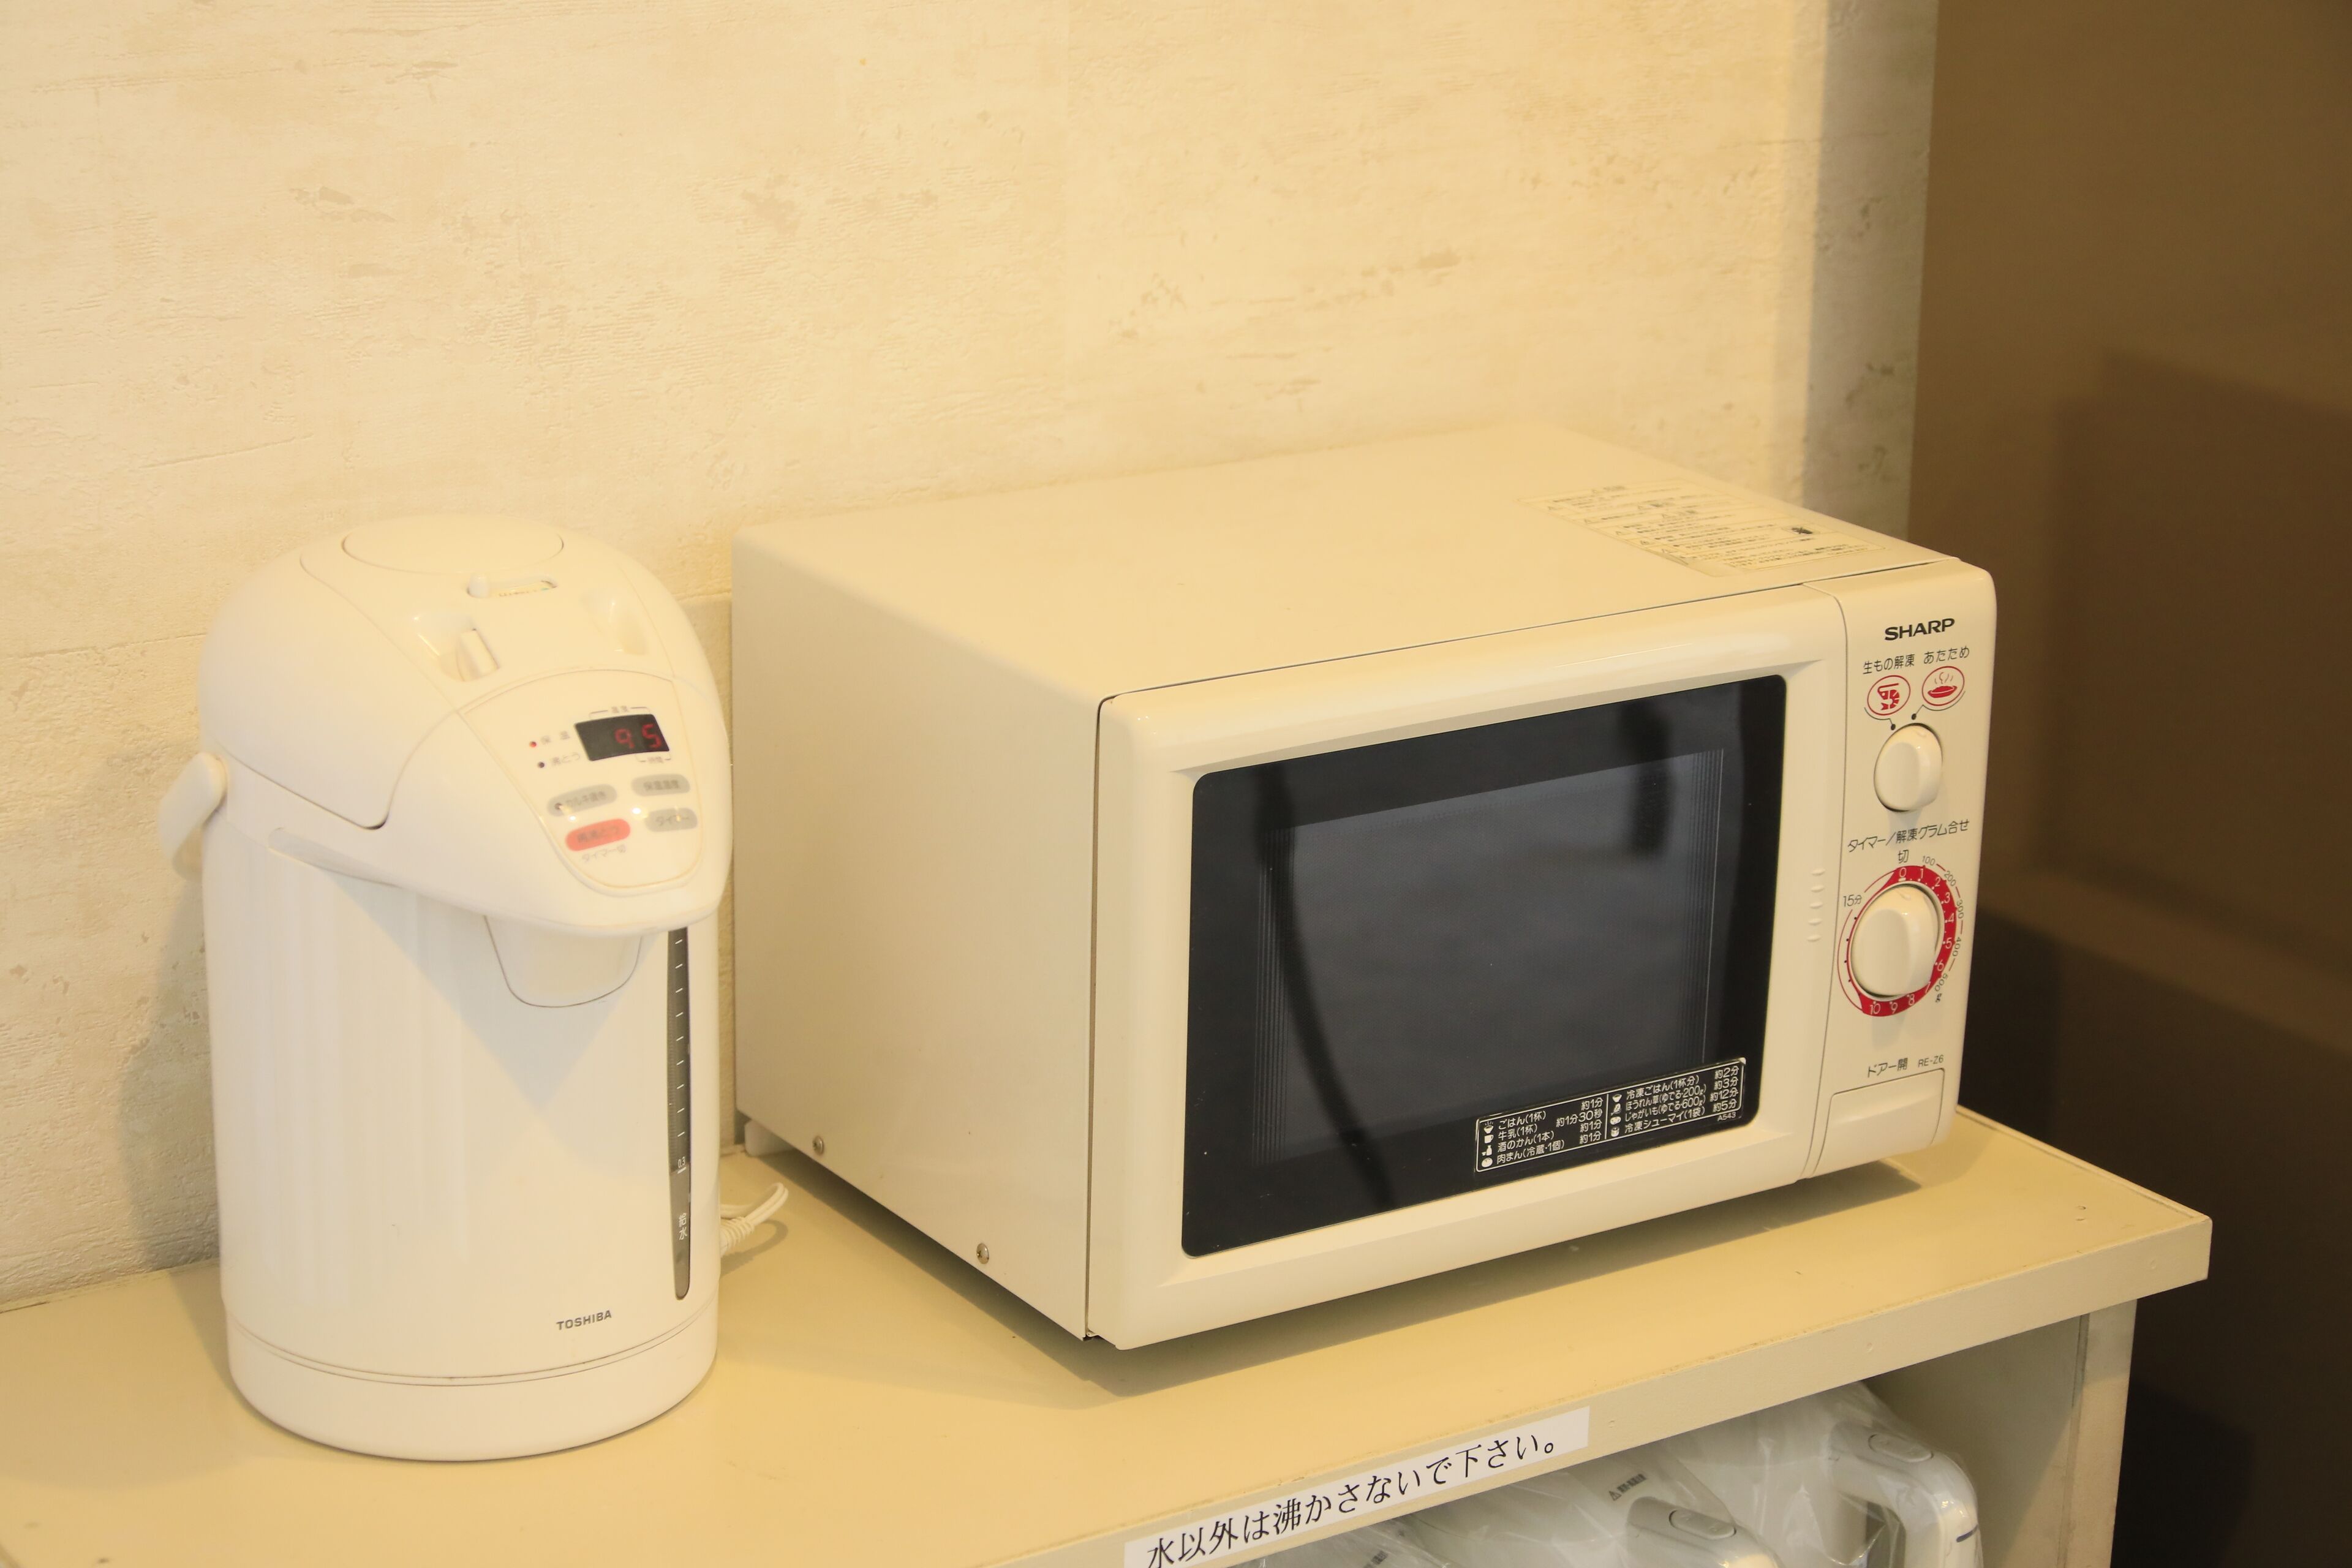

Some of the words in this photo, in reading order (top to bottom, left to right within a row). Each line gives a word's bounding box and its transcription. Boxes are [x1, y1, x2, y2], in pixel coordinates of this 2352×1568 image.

[1885, 618, 1955, 641] SHARP
[1863, 653, 1915, 674] 生もの解凍
[1923, 646, 1970, 665] あたため
[614, 723, 662, 748] 95
[1847, 819, 1969, 853] タイマー/解凍グラム合せ
[1898, 850, 1909, 864] 切
[1922, 856, 1936, 866] 100
[1899, 867, 1907, 878] 0
[1920, 868, 1924, 879] 1
[1944, 870, 1956, 887] 200
[1934, 876, 1941, 887] 2
[1842, 894, 1862, 907] 15分
[1944, 892, 1950, 903] 3
[1948, 913, 1954, 923] 4
[1945, 937, 1952, 949] 5
[1952, 937, 1961, 957] 400
[1937, 959, 1944, 971] 6
[1908, 993, 1915, 1006] 8
[1870, 1003, 1881, 1015] 10
[1890, 1002, 1898, 1014] 9
[1714, 1065, 1740, 1080] 約2分
[1868, 1057, 1908, 1078] ドアー開
[1918, 1054, 1944, 1068] RE-Z6
[1714, 1076, 1739, 1091] 約3分
[1709, 1087, 1739, 1102] 約12分
[1713, 1098, 1738, 1113] 約5分
[1498, 1110, 1547, 1130] ごはん(1杯)
[1581, 1097, 1604, 1110] 約1分
[1717, 1112, 1736, 1122] A543
[1498, 1123, 1538, 1141] 牛乳(1杯)
[1556, 1109, 1603, 1128] 約1分30秒
[1498, 1130, 1555, 1153] 酒のかん(1本)
[1580, 1119, 1602, 1133] 約1分
[1579, 1131, 1602, 1145] 約1分
[678, 1212, 687, 1240] 給水
[556, 1310, 612, 1330] TOSHIBA
[1147, 1434, 1554, 1568] 水以外は沸かさないで下さい。
